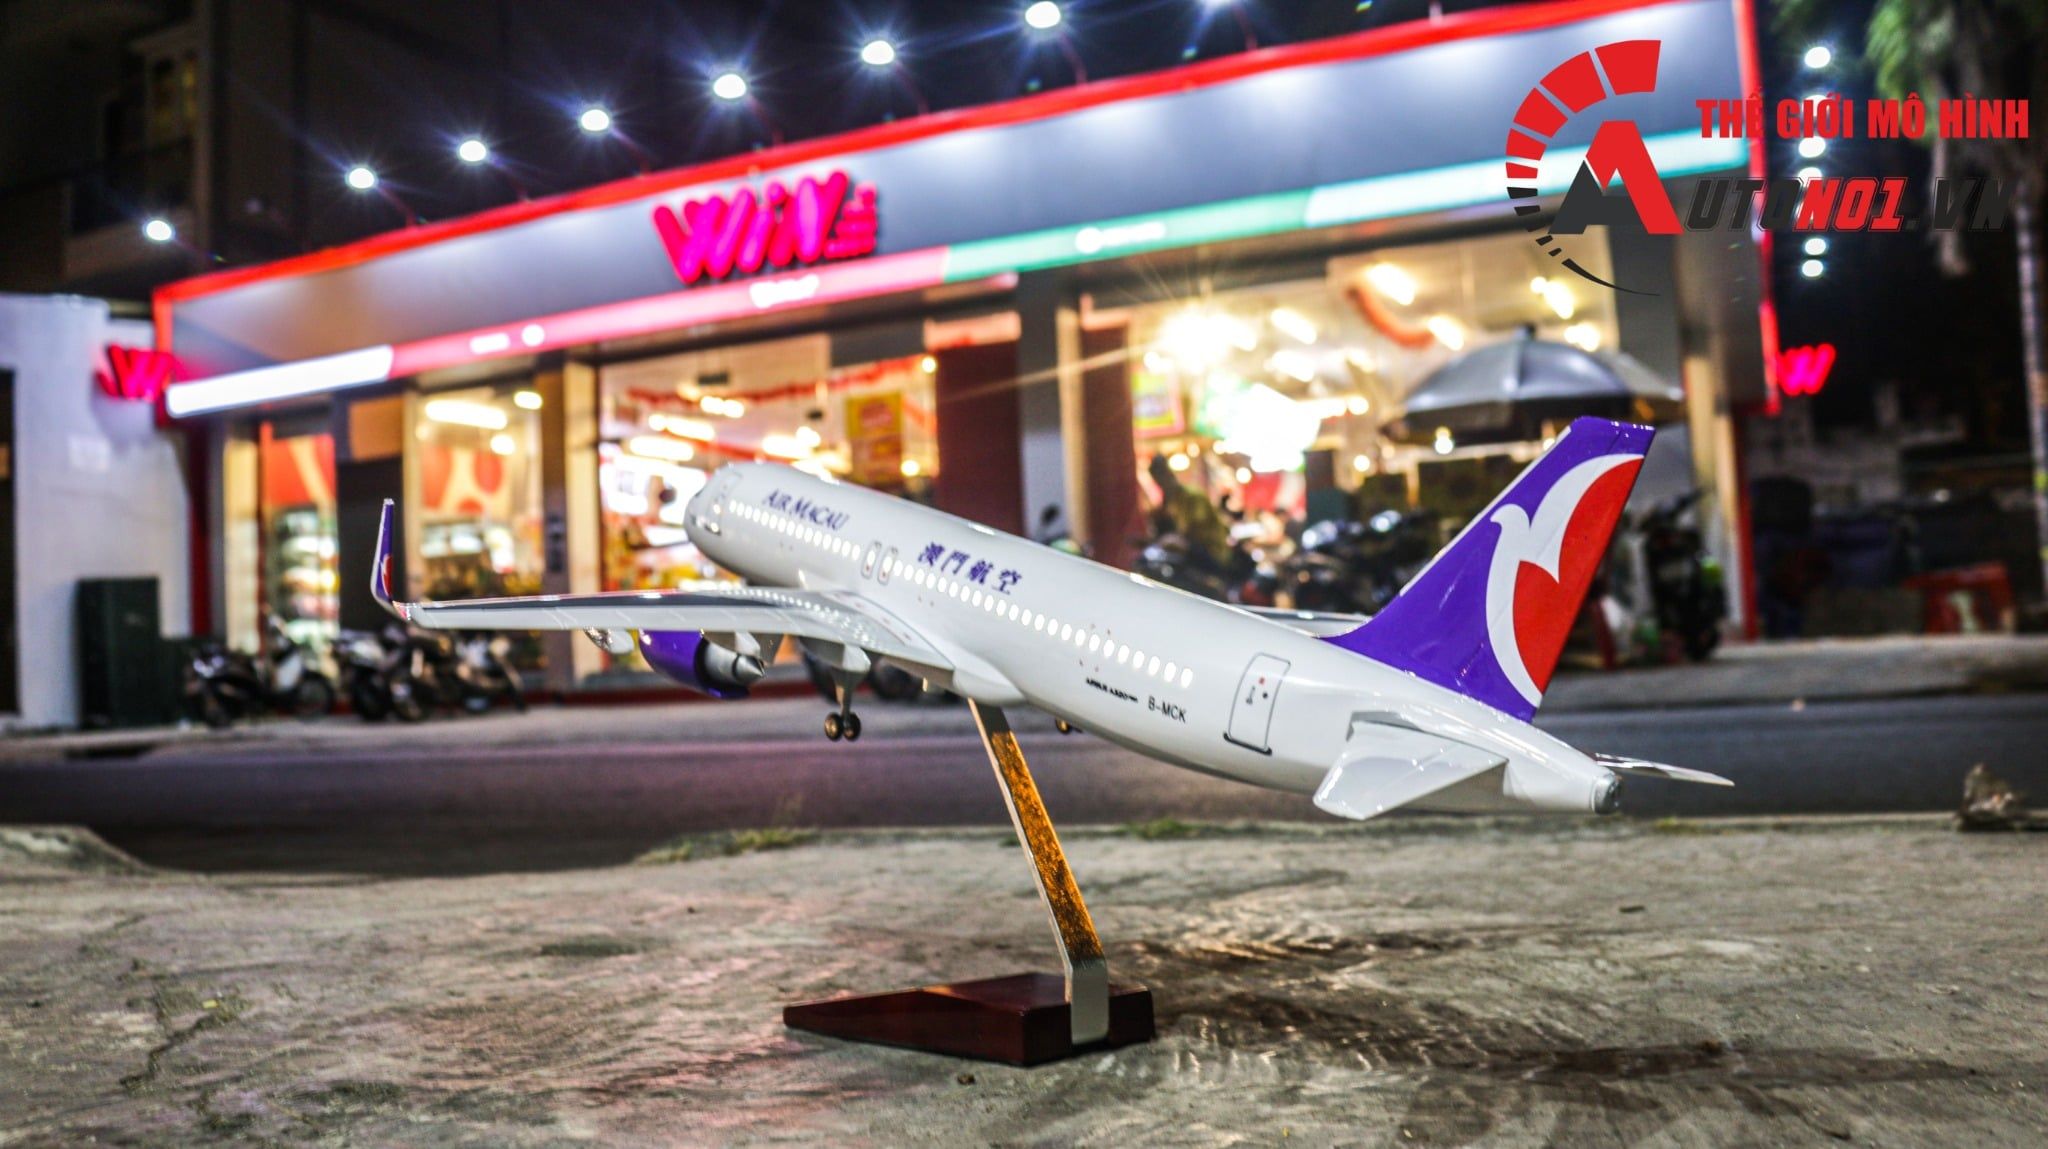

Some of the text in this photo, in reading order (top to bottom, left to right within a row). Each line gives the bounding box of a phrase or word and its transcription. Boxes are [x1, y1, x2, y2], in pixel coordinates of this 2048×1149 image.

[917, 541, 1022, 595] 澳門航空
[1147, 695, 1186, 723] B-MCK
